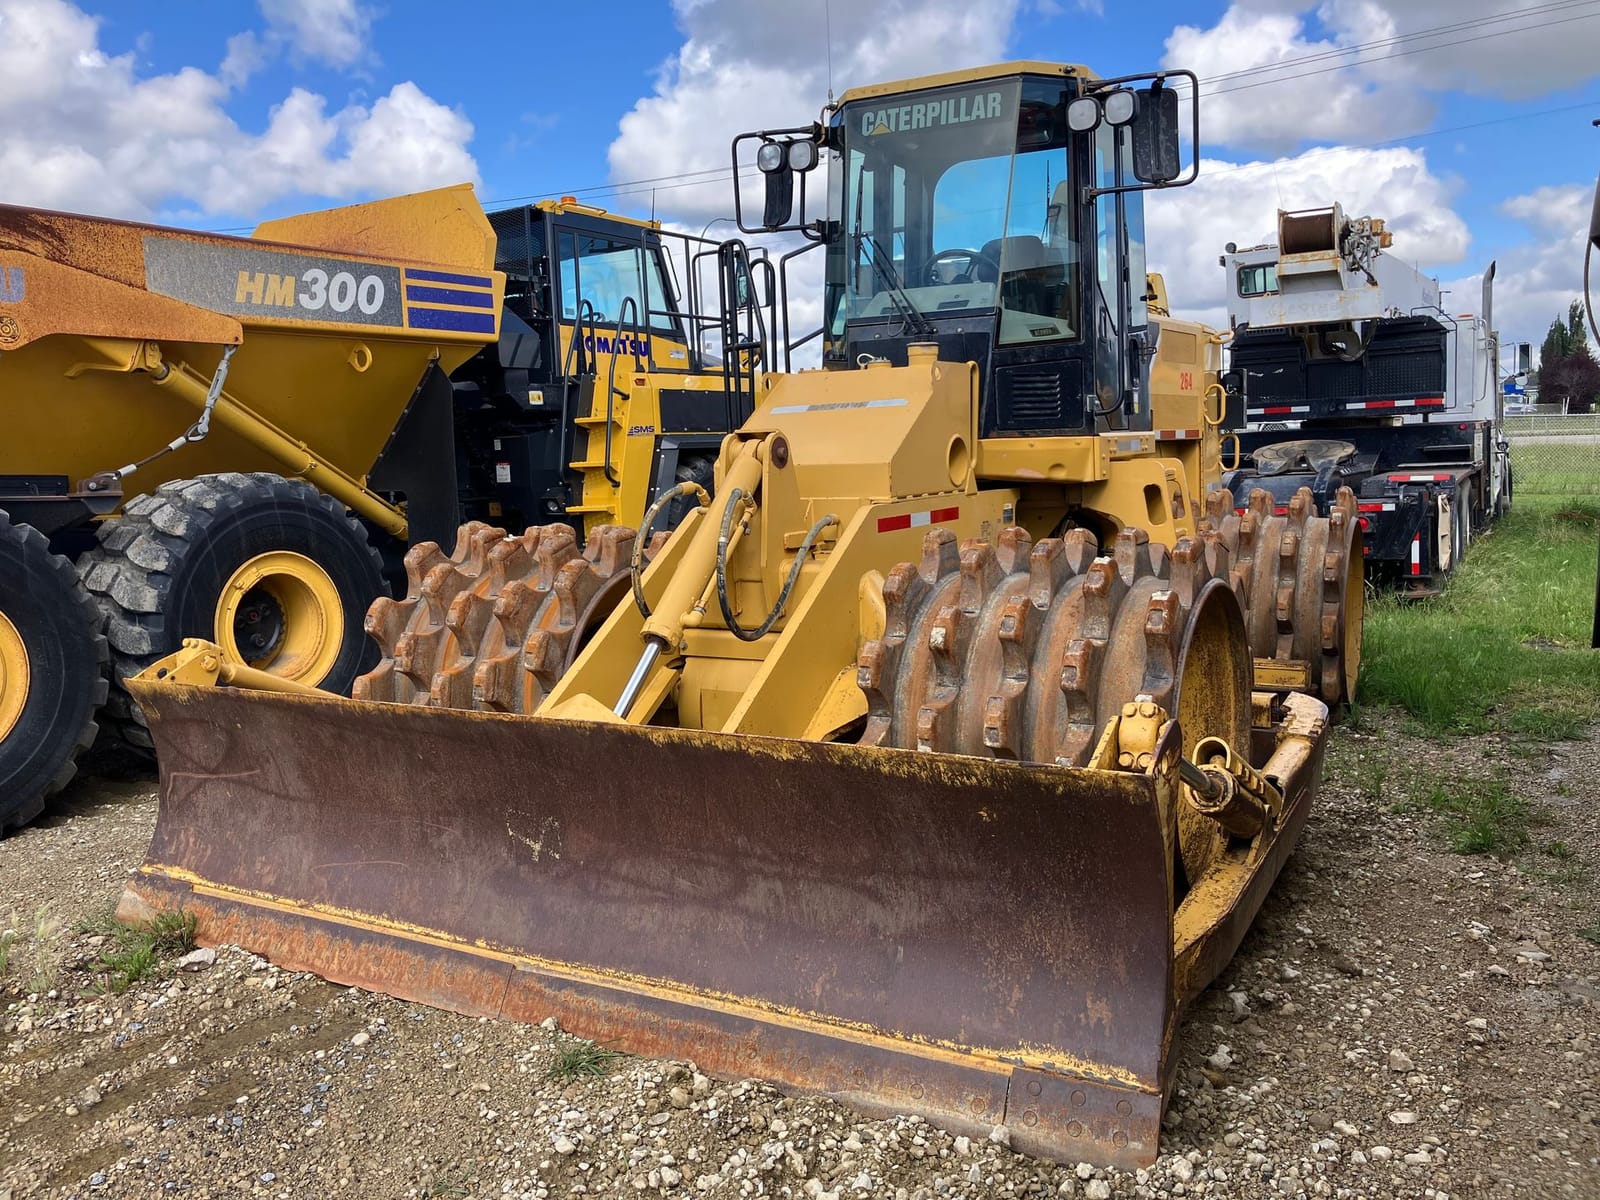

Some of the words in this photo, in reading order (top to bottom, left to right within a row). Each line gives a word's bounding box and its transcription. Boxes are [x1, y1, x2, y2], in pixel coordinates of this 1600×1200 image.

[861, 92, 1002, 137] CATERPILLAR
[573, 334, 650, 357] OMATSU
[1180, 372, 1193, 391] 264
[633, 425, 655, 434] SMS
